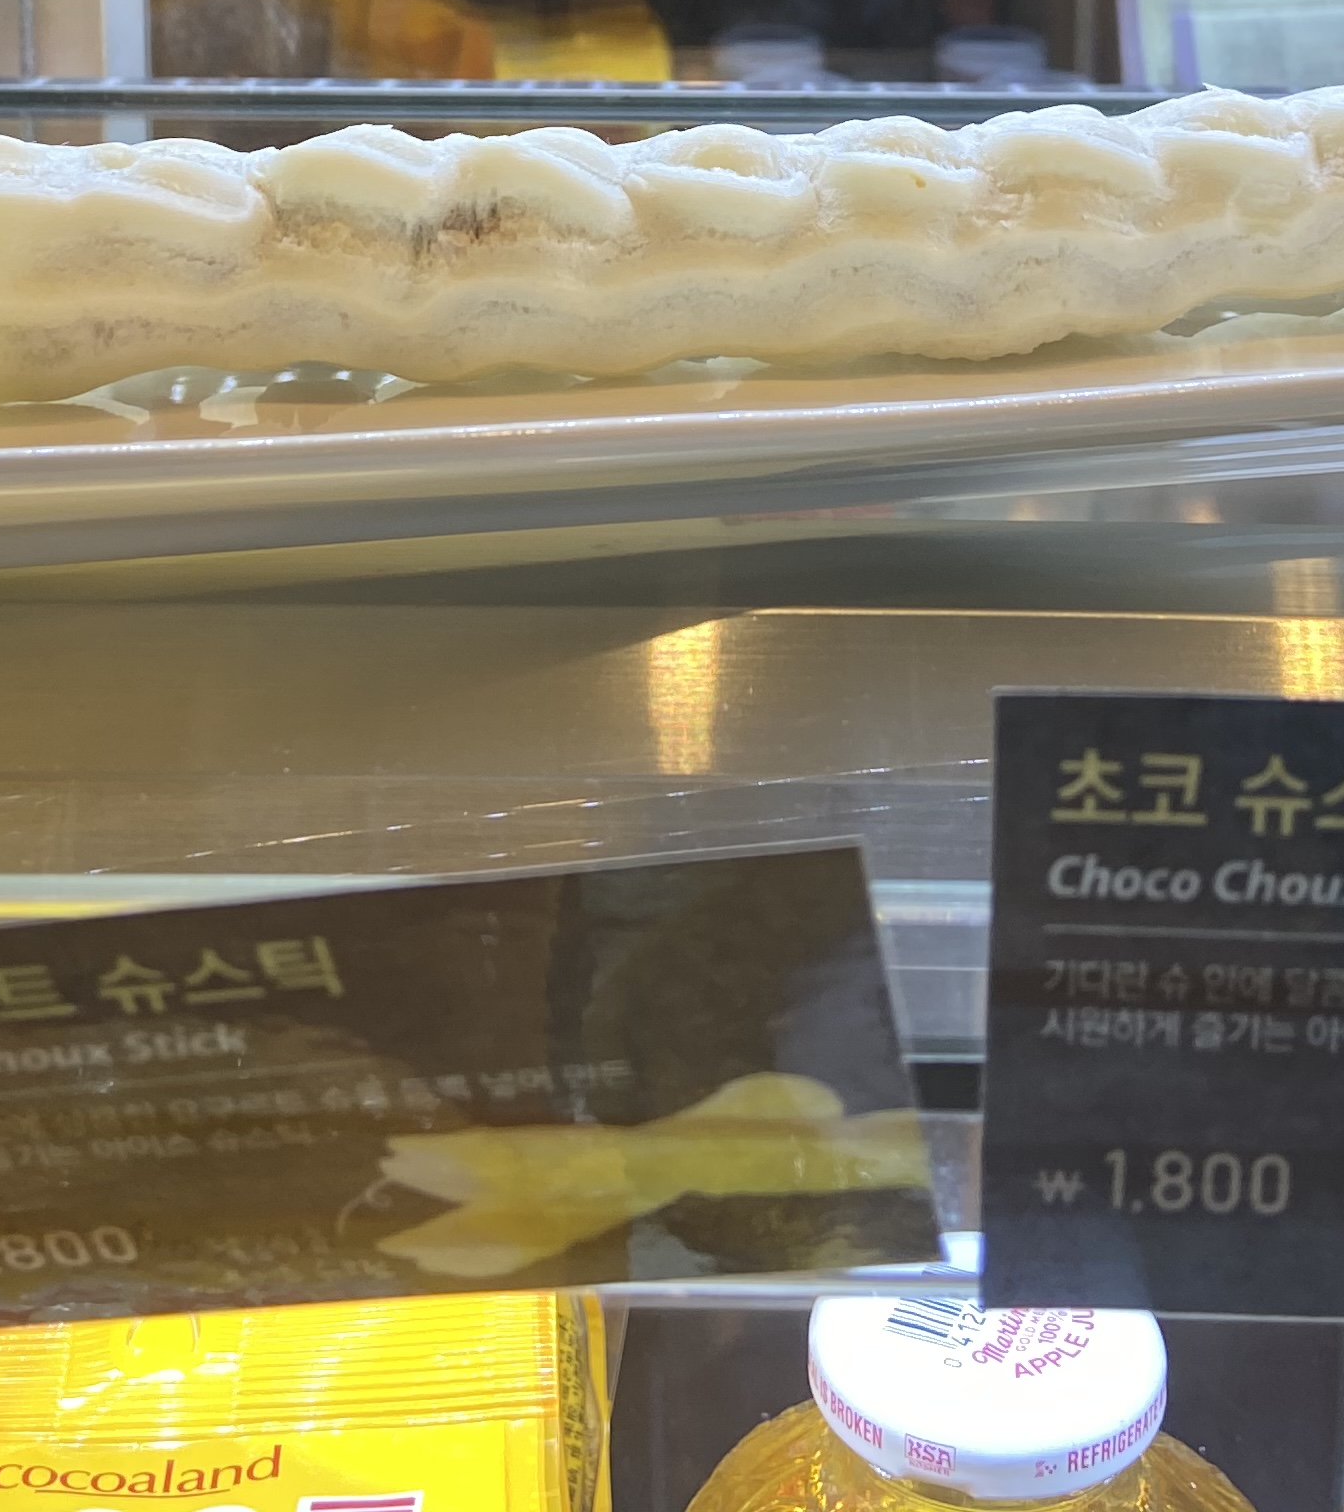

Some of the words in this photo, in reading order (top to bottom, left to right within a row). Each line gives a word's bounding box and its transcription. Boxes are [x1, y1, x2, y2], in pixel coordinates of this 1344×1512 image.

[1050, 748, 1208, 826] 초코
[1047, 854, 1201, 901] Choco
[98, 935, 344, 1017] 슈스틱
[1043, 960, 1148, 1000] 기다란
[1157, 962, 1191, 1001] 슈
[1202, 963, 1274, 1004] 안에
[123, 1023, 248, 1062] Stick
[1040, 1007, 1184, 1048] 시원하게
[1192, 1010, 1296, 1054] 즐기는
[1015, 1326, 1038, 1352] GOLD
[1038, 1309, 1068, 1344] 100%
[1014, 1332, 1090, 1379] APPLE
[830, 1387, 884, 1450] BROKEN
[1067, 1396, 1159, 1474] REFRIGERATE
[907, 1437, 954, 1471] KSA
